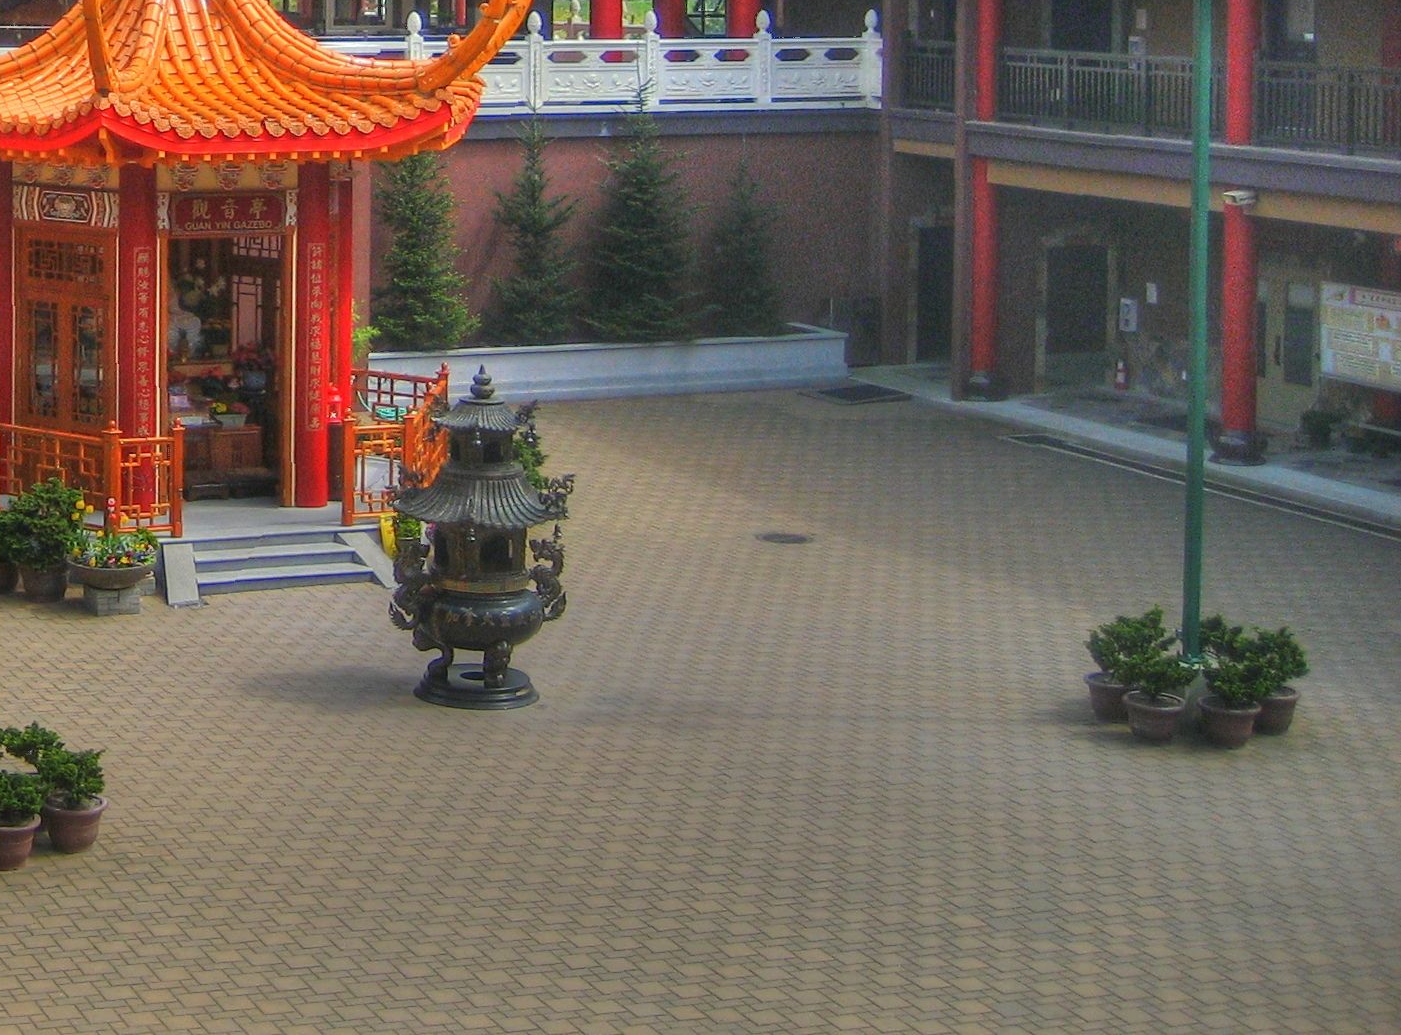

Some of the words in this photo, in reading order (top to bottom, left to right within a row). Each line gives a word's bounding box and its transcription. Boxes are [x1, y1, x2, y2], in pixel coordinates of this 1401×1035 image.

[191, 198, 267, 220] 觀音亭
[185, 221, 212, 230] GUAN
[215, 221, 231, 229] YIN
[233, 220, 273, 229] GAZEBO
